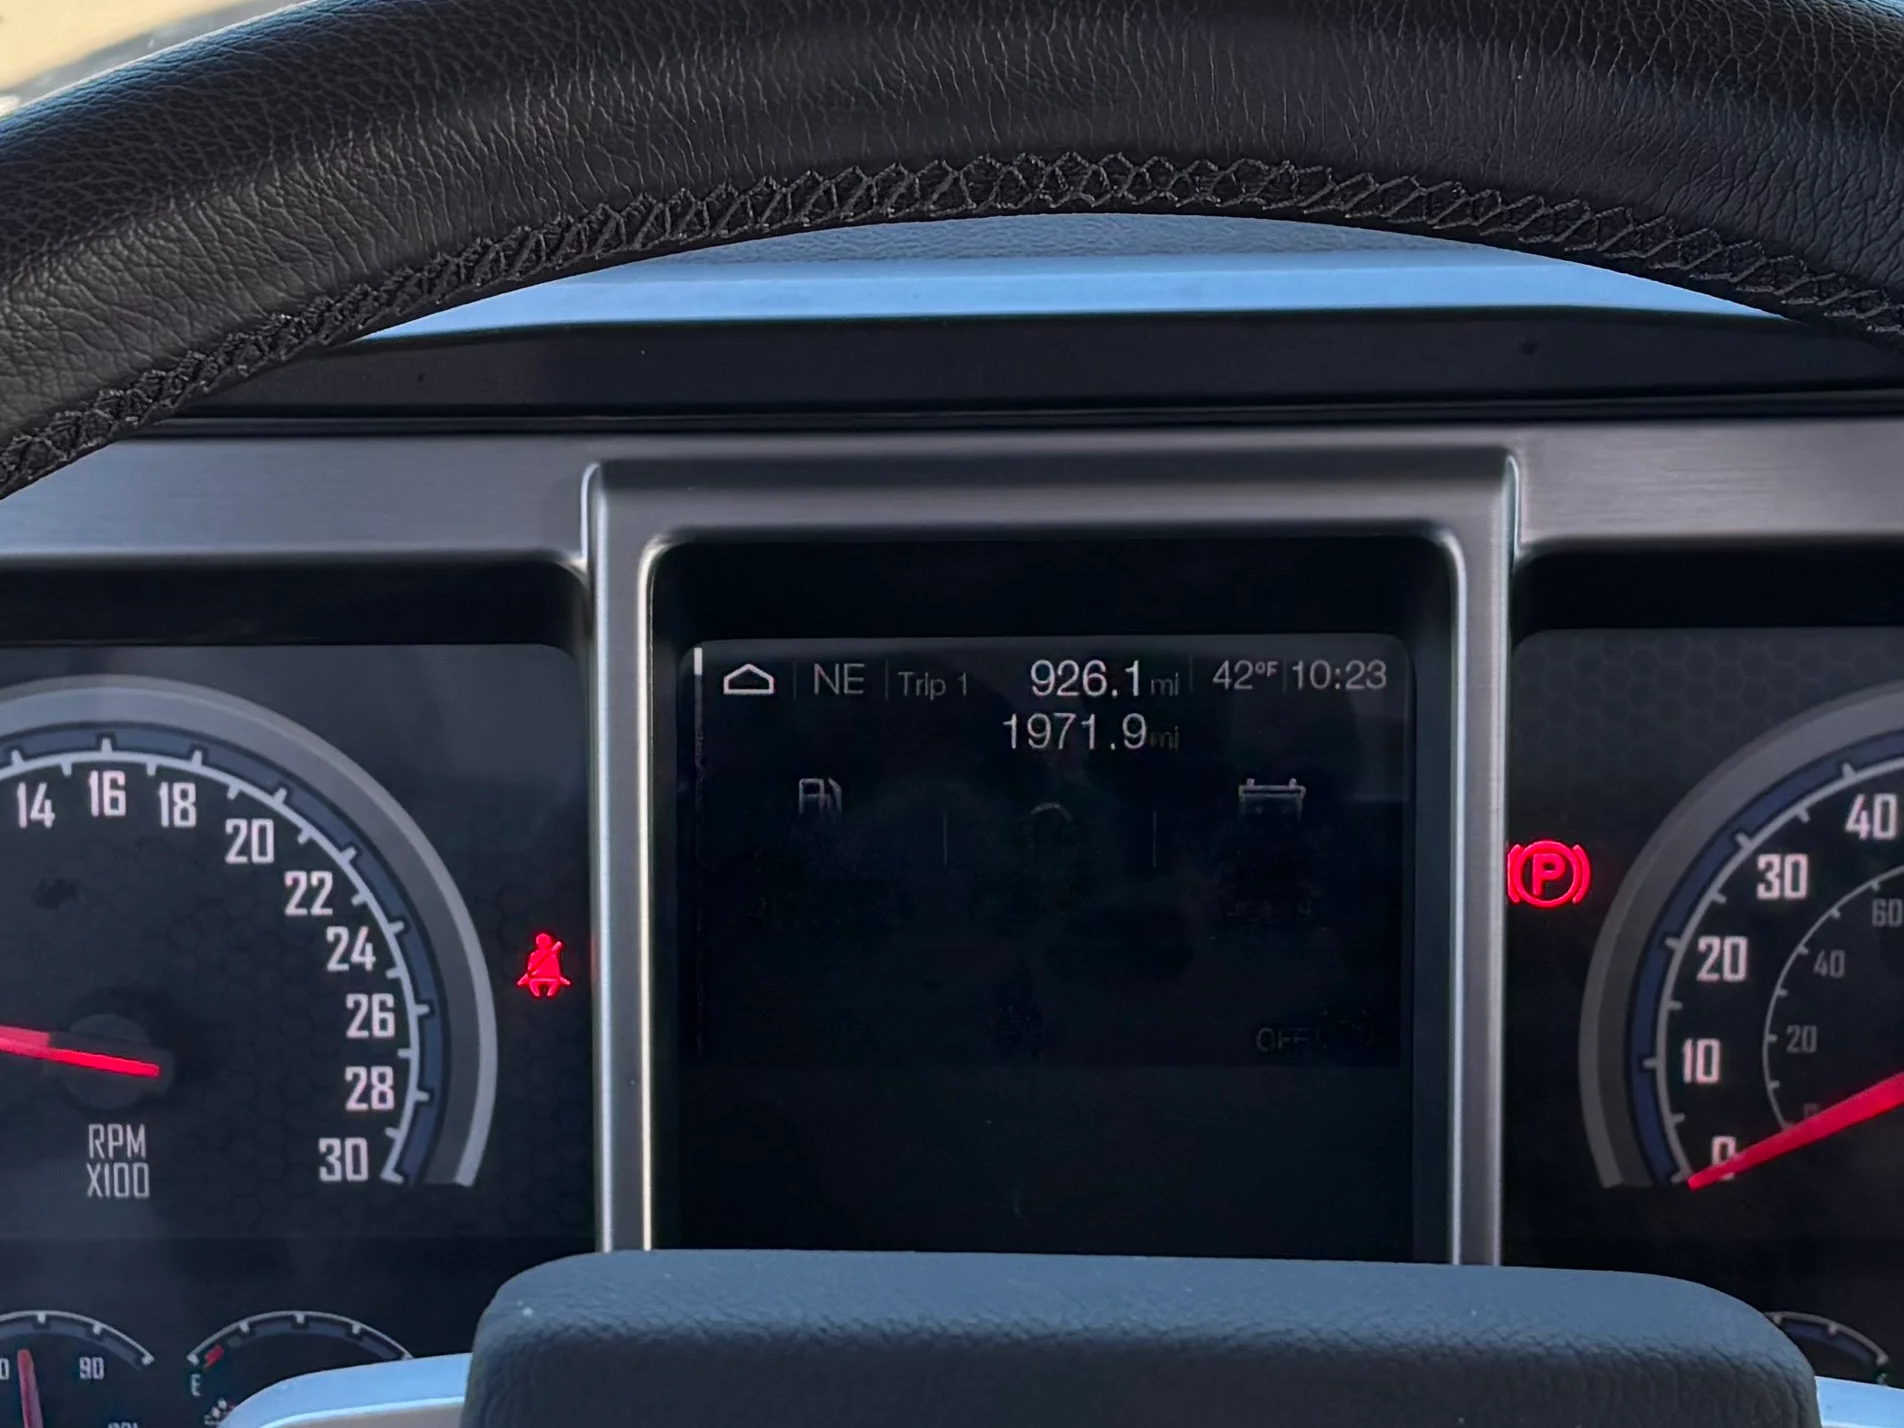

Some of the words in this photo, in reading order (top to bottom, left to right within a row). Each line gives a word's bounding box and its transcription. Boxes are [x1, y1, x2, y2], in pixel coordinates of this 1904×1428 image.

[813, 662, 865, 695] NE
[897, 670, 946, 700] Trip
[1030, 659, 1139, 697] 926.1
[1292, 660, 1387, 690] 10:23
[1003, 713, 1147, 750] 1971.9
[16, 782, 55, 828] 14
[88, 770, 126, 817] 16
[158, 782, 197, 827] 18
[1845, 793, 1897, 839] 40
[225, 818, 274, 864] 20
[284, 870, 333, 916] 22
[1757, 853, 1808, 899] 30
[1871, 898, 1903, 927] 60
[326, 926, 376, 971] 24
[1697, 936, 1747, 981] 20
[1813, 949, 1845, 978] 40
[346, 993, 395, 1038] 26
[1786, 1024, 1817, 1053] 20
[1684, 1040, 1720, 1083] 10
[345, 1066, 394, 1111] 28
[88, 1123, 146, 1159] RPM
[318, 1137, 369, 1182] 30
[86, 1162, 149, 1198] X100
[79, 1356, 105, 1380] 90
[191, 1373, 201, 1397] E
